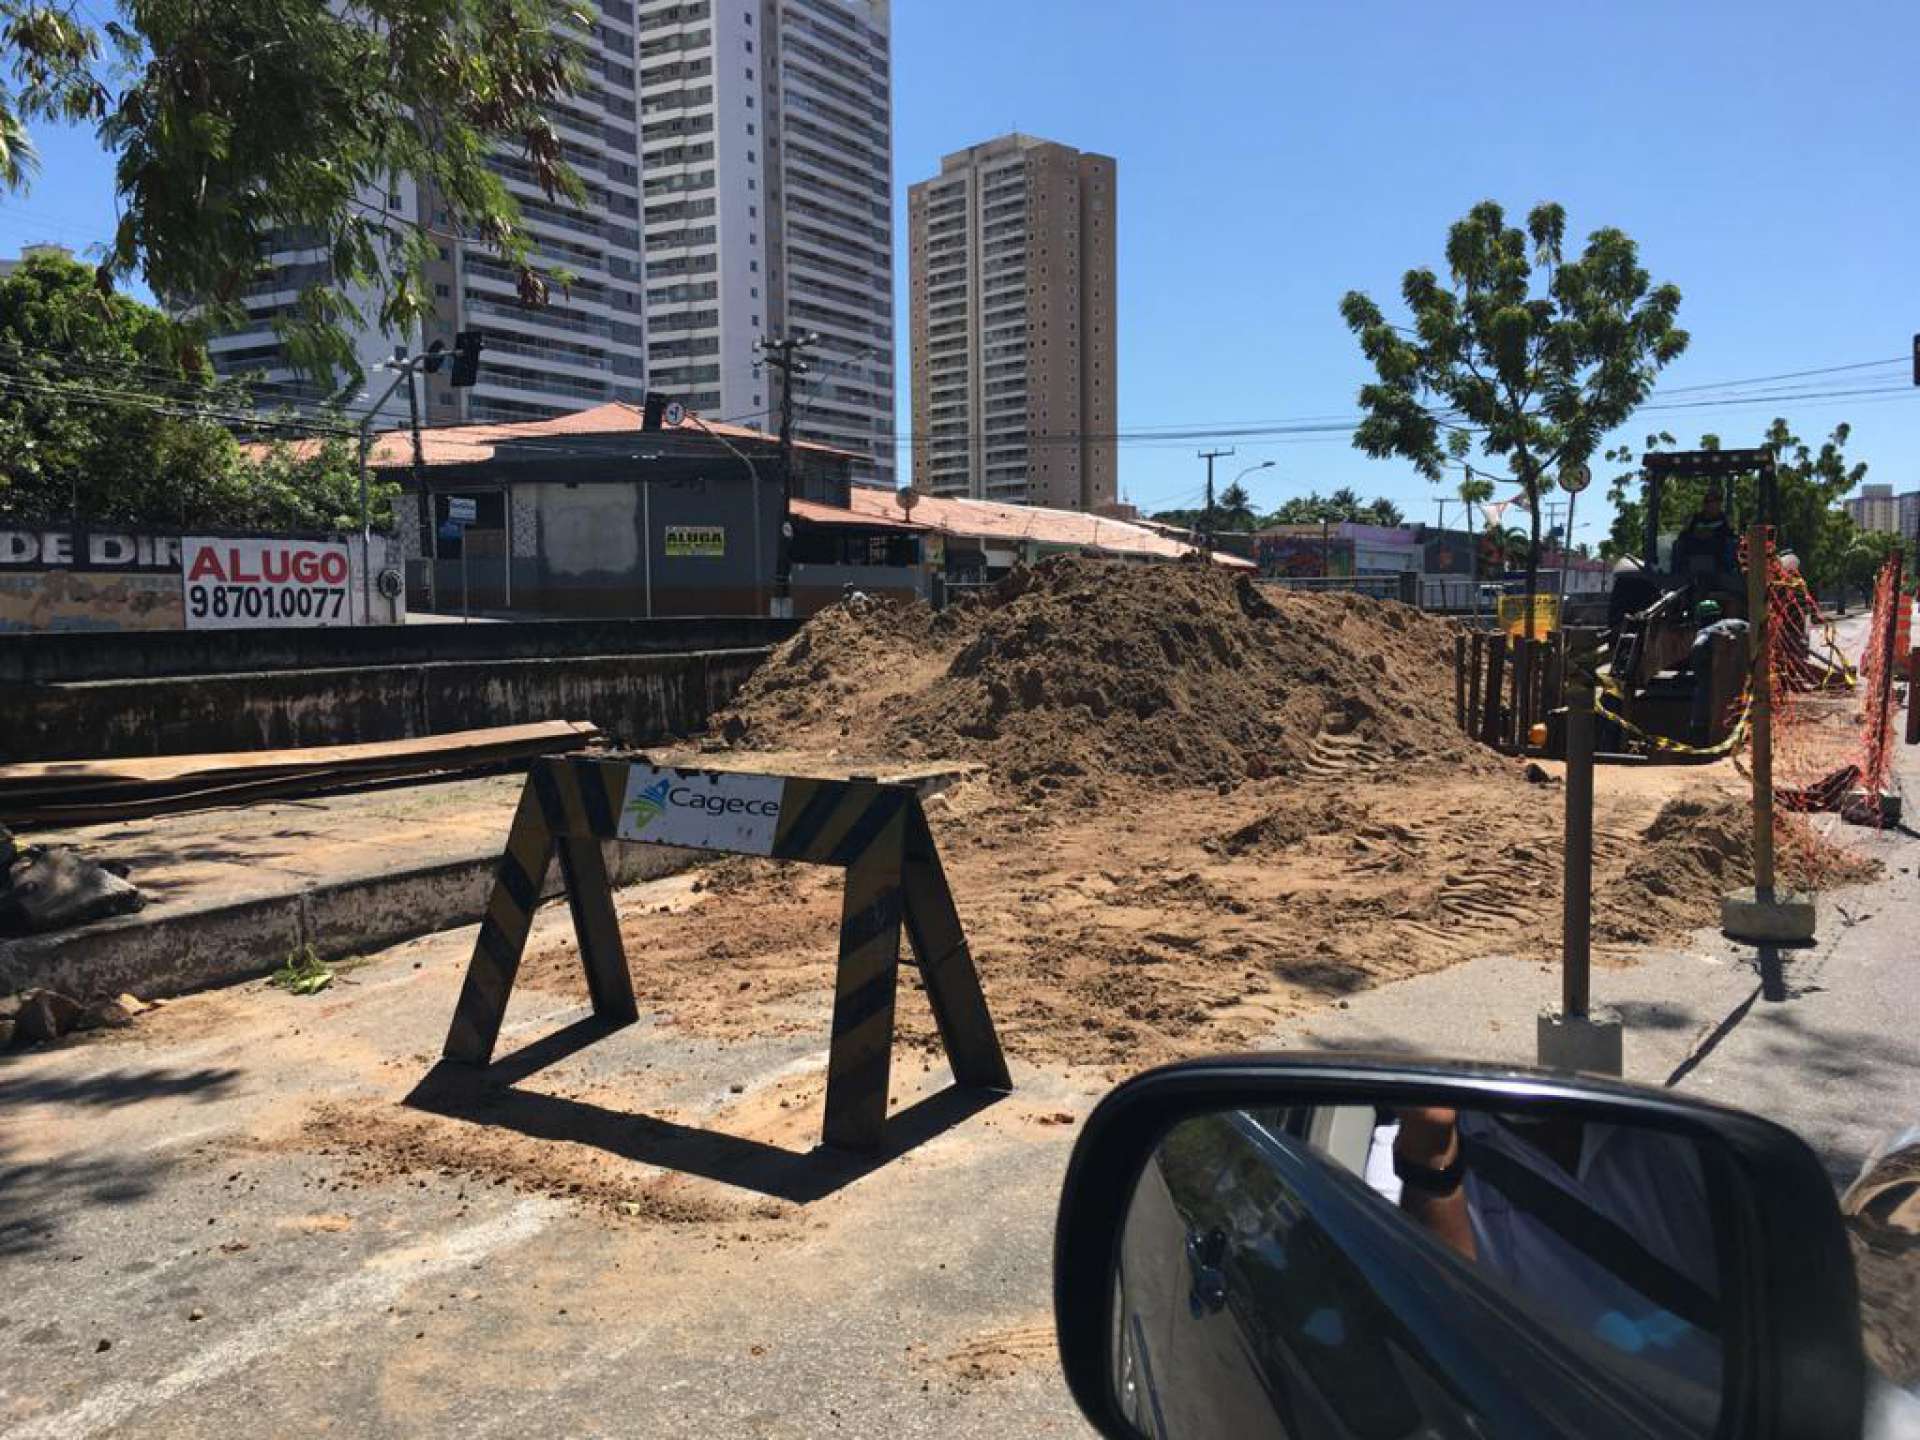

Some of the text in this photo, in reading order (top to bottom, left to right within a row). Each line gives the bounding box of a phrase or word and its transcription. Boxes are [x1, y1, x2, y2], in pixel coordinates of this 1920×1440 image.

[0, 532, 74, 564] DE
[188, 546, 348, 584] ALUGO
[669, 787, 779, 816] Cagece
